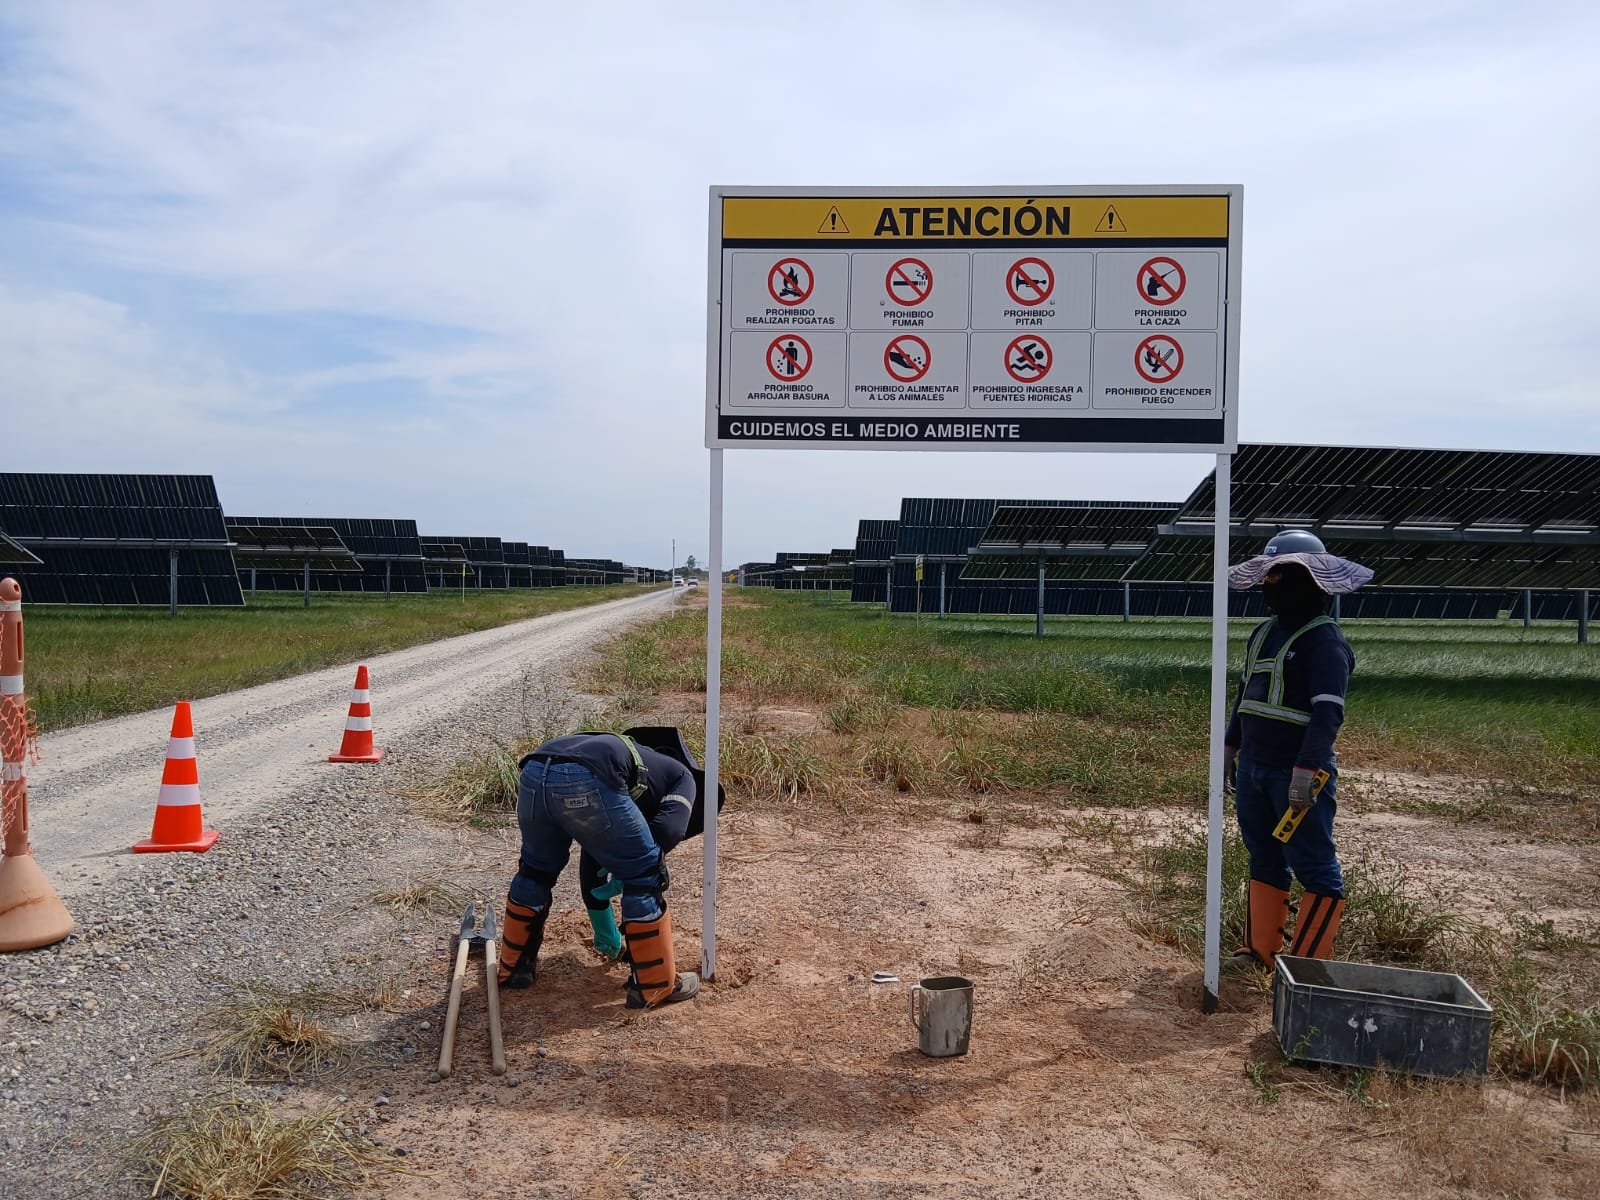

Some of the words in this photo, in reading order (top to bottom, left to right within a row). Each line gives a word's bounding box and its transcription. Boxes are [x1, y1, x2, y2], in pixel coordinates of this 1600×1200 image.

[874, 200, 1071, 236] ATENCIÓN
[765, 309, 816, 317] PROHIBIDO
[883, 311, 934, 319] PROHIBIDO
[1003, 310, 1056, 318] PROHIBIDO
[1134, 310, 1188, 318] PROHIBIDO
[745, 317, 790, 325] REALIZAR
[791, 317, 836, 325] FOGATAS
[891, 319, 925, 327] FUMAR
[1015, 318, 1043, 326] PITAR
[1140, 318, 1153, 326] LA
[1154, 318, 1181, 326] CAZA
[764, 384, 814, 392] PROHIBIDO
[854, 385, 905, 393] PROHIBIDO
[906, 385, 960, 393] ALIMENTAR
[972, 385, 1025, 393] PROHIBIDO
[1025, 385, 1074, 393] INGRESAR
[1075, 386, 1083, 394] A
[1104, 387, 1158, 395] PROHIBIDO
[1159, 387, 1212, 396] ENCENDER
[747, 392, 791, 400] ARROJAR
[792, 392, 830, 401] BASURA
[868, 393, 876, 401] A
[877, 393, 897, 401] LOS
[898, 393, 945, 402] ANIMALES
[983, 394, 1026, 402] FUENTES
[1027, 394, 1072, 402] HIDRICAS
[1141, 396, 1175, 404] FUEGO
[729, 422, 826, 437] CUIDEMOS
[831, 423, 854, 437] EL
[860, 423, 919, 438] MEDIO
[924, 424, 1020, 438] AMBIENTE
